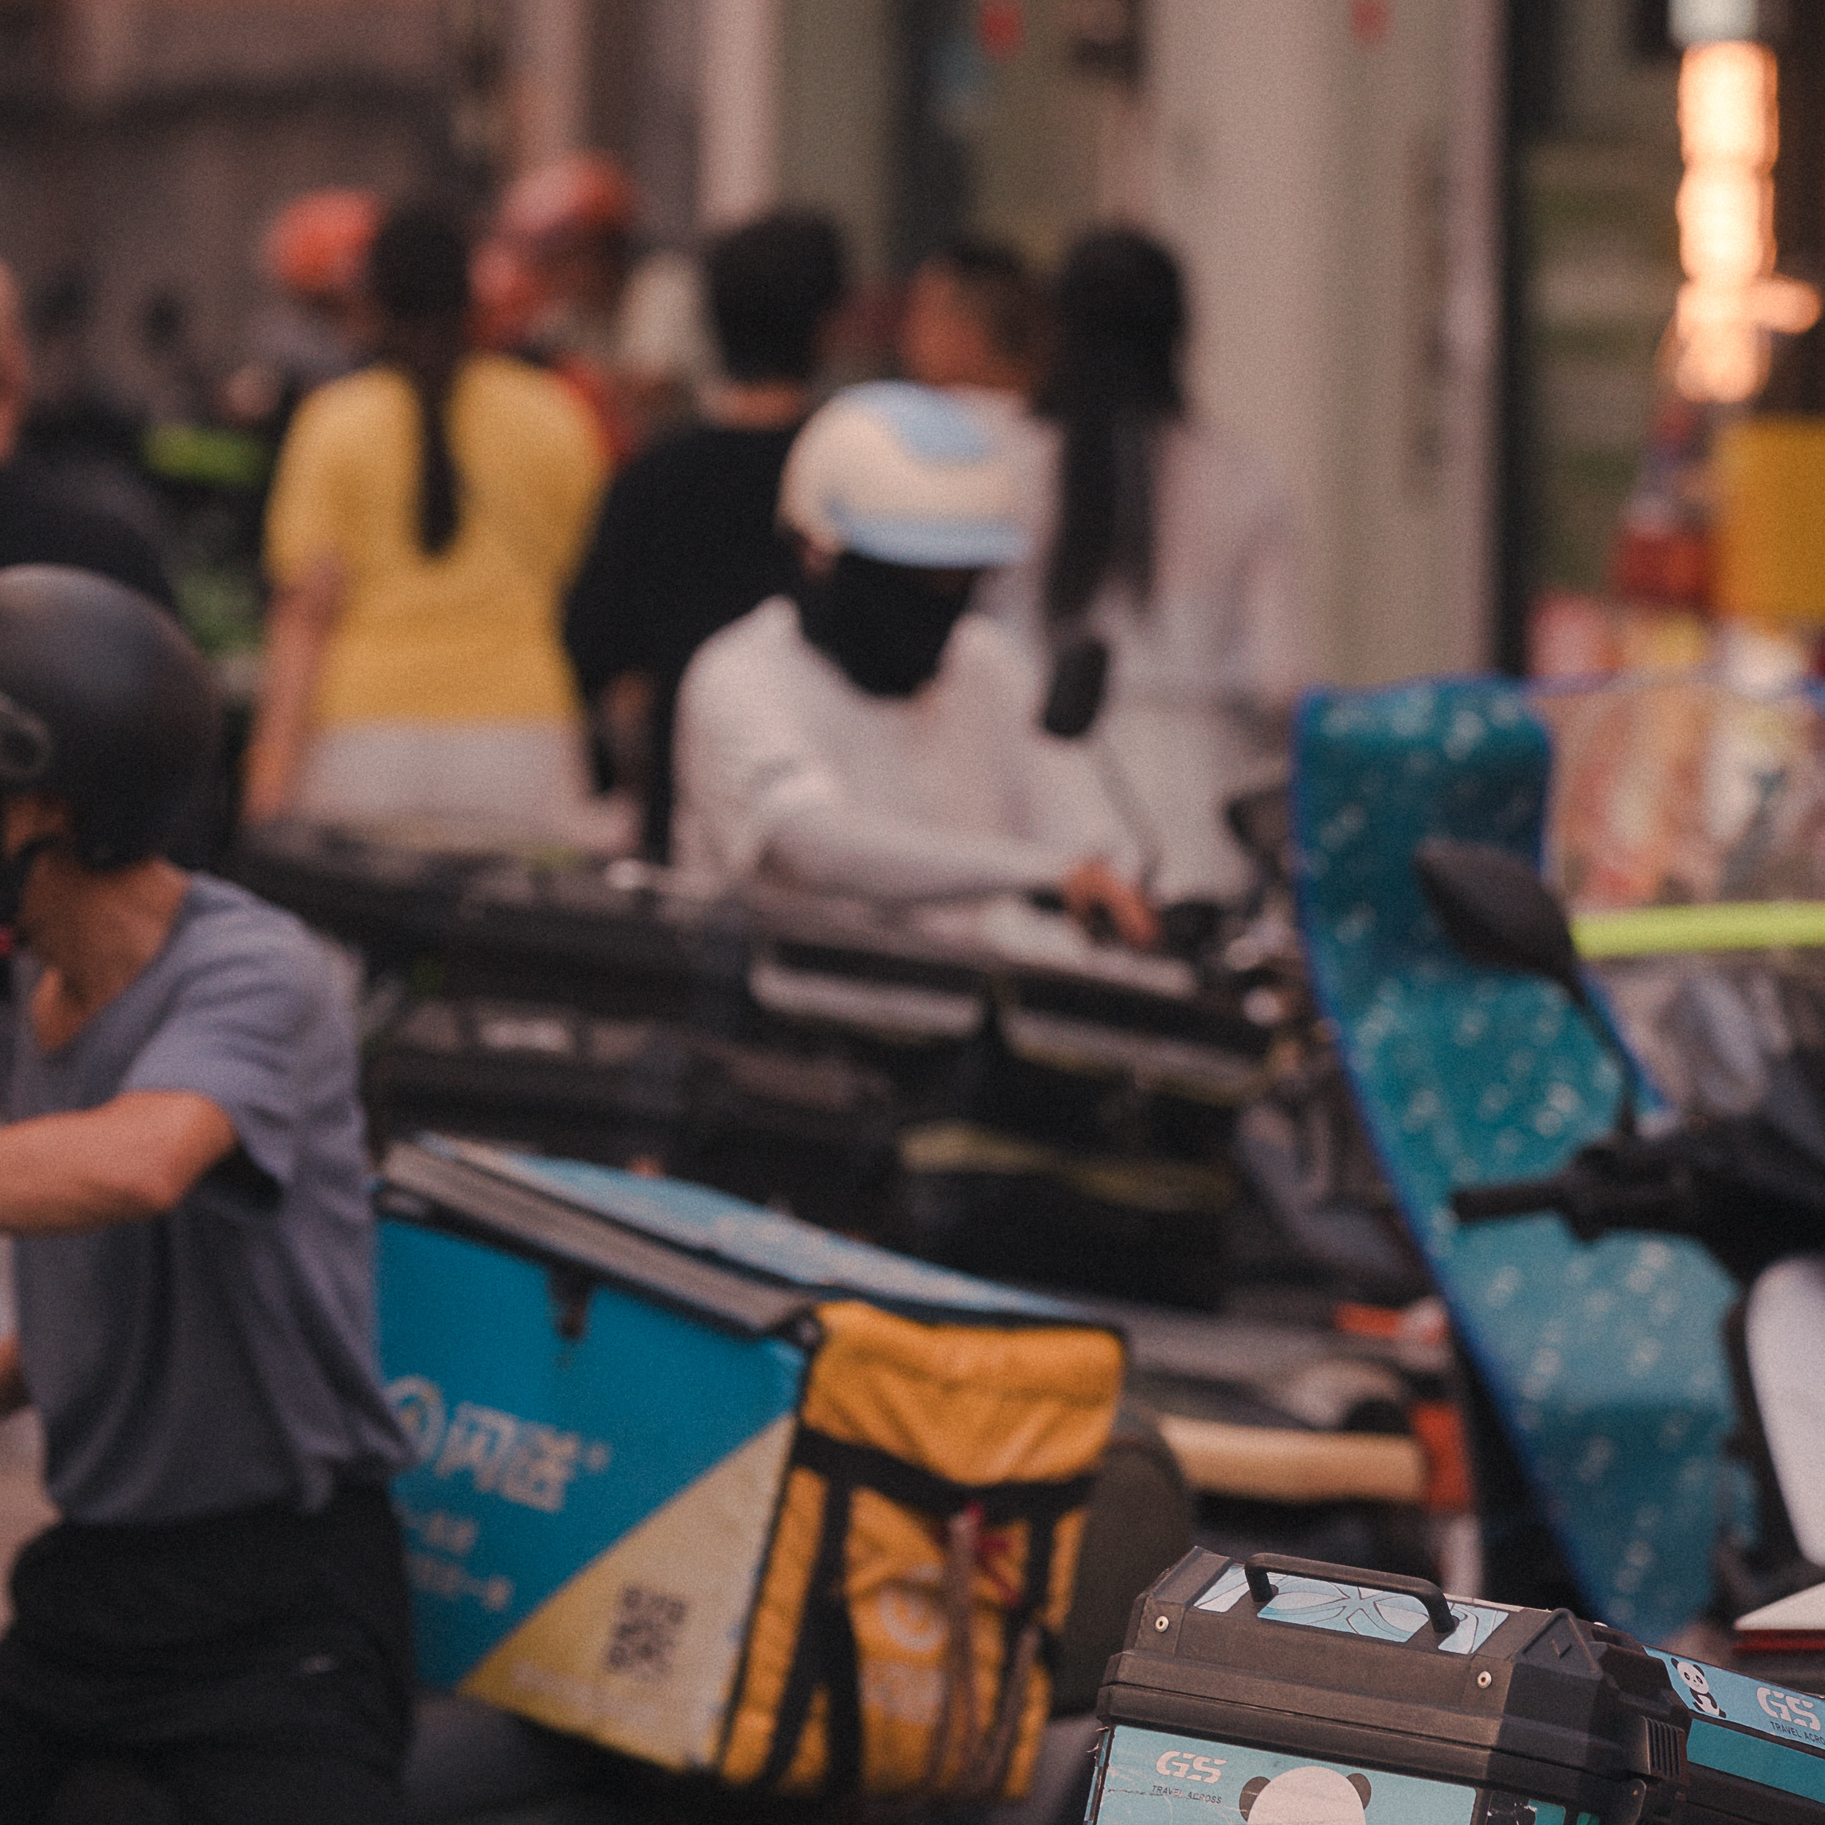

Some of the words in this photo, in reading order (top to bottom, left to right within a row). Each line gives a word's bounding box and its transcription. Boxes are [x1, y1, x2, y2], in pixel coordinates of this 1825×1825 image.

[1755, 1686, 1822, 1732] GS
[1769, 1720, 1802, 1738] TRAVEL
[1155, 1750, 1228, 1784] GS
[1152, 1784, 1183, 1799] TRAVEL
[1187, 1791, 1223, 1805] ACROSS
